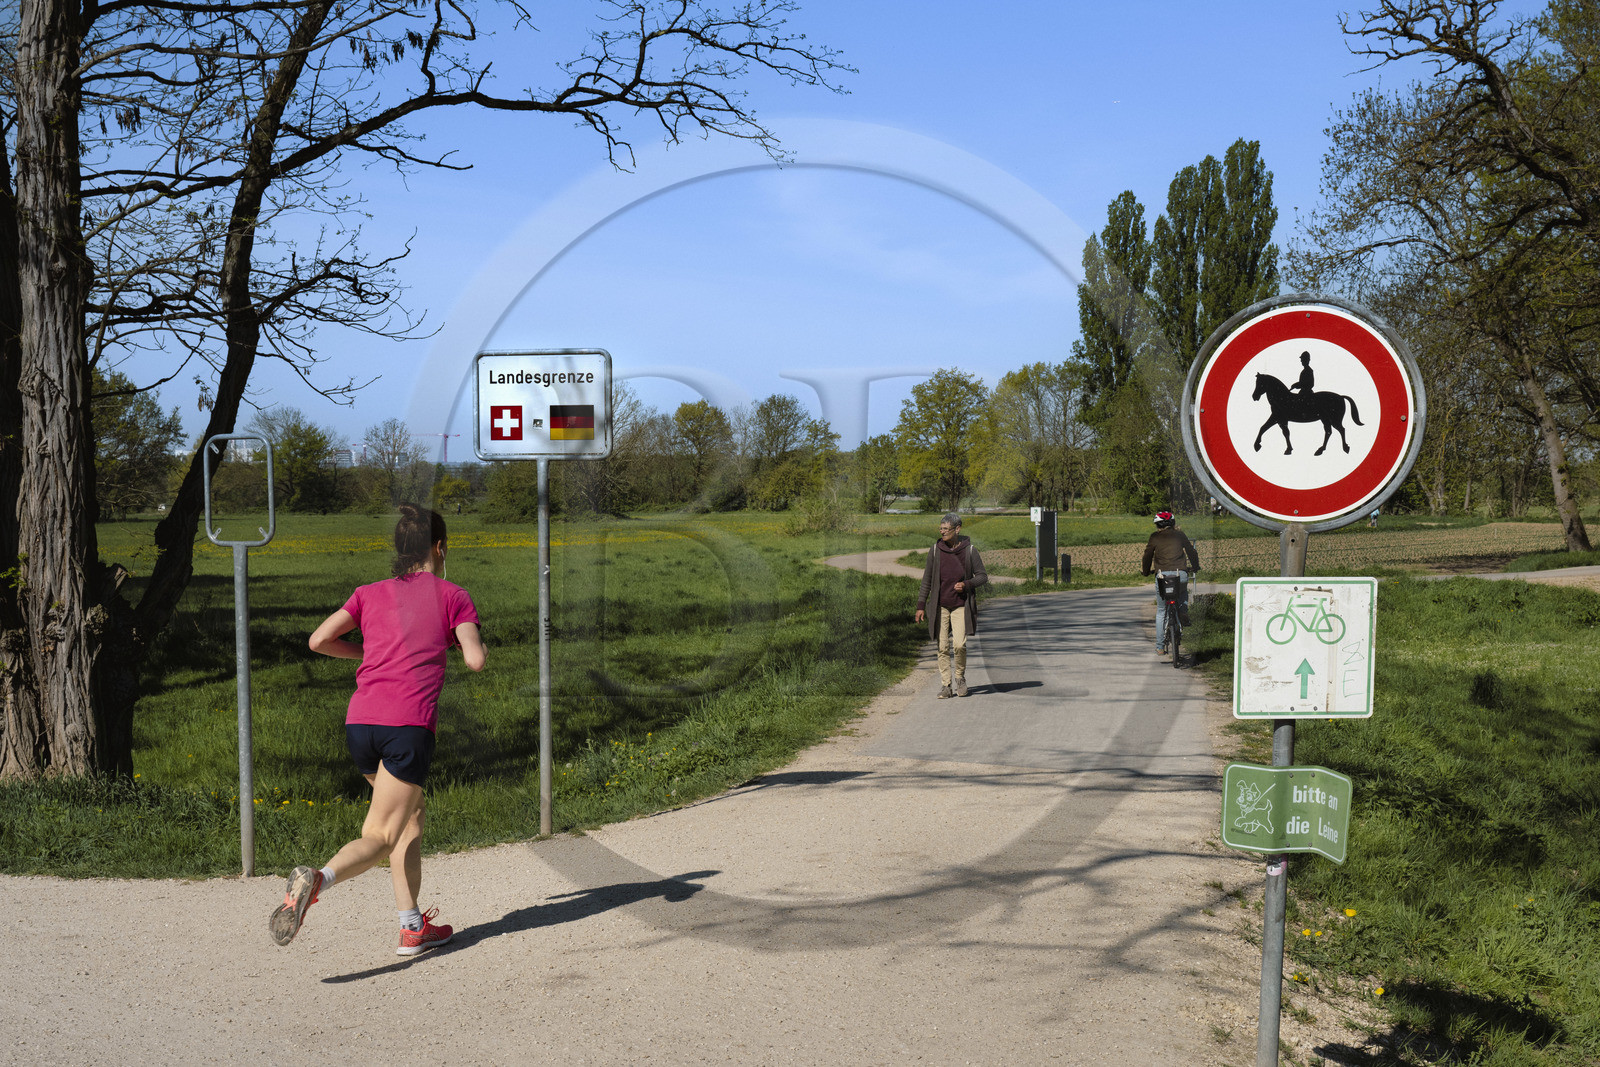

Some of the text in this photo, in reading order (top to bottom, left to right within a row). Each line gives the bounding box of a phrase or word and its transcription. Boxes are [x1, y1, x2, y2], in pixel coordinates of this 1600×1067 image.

[489, 370, 594, 387] Landesgrenze
[1293, 785, 1338, 811] bitte an
[1286, 816, 1339, 844] die Leine
